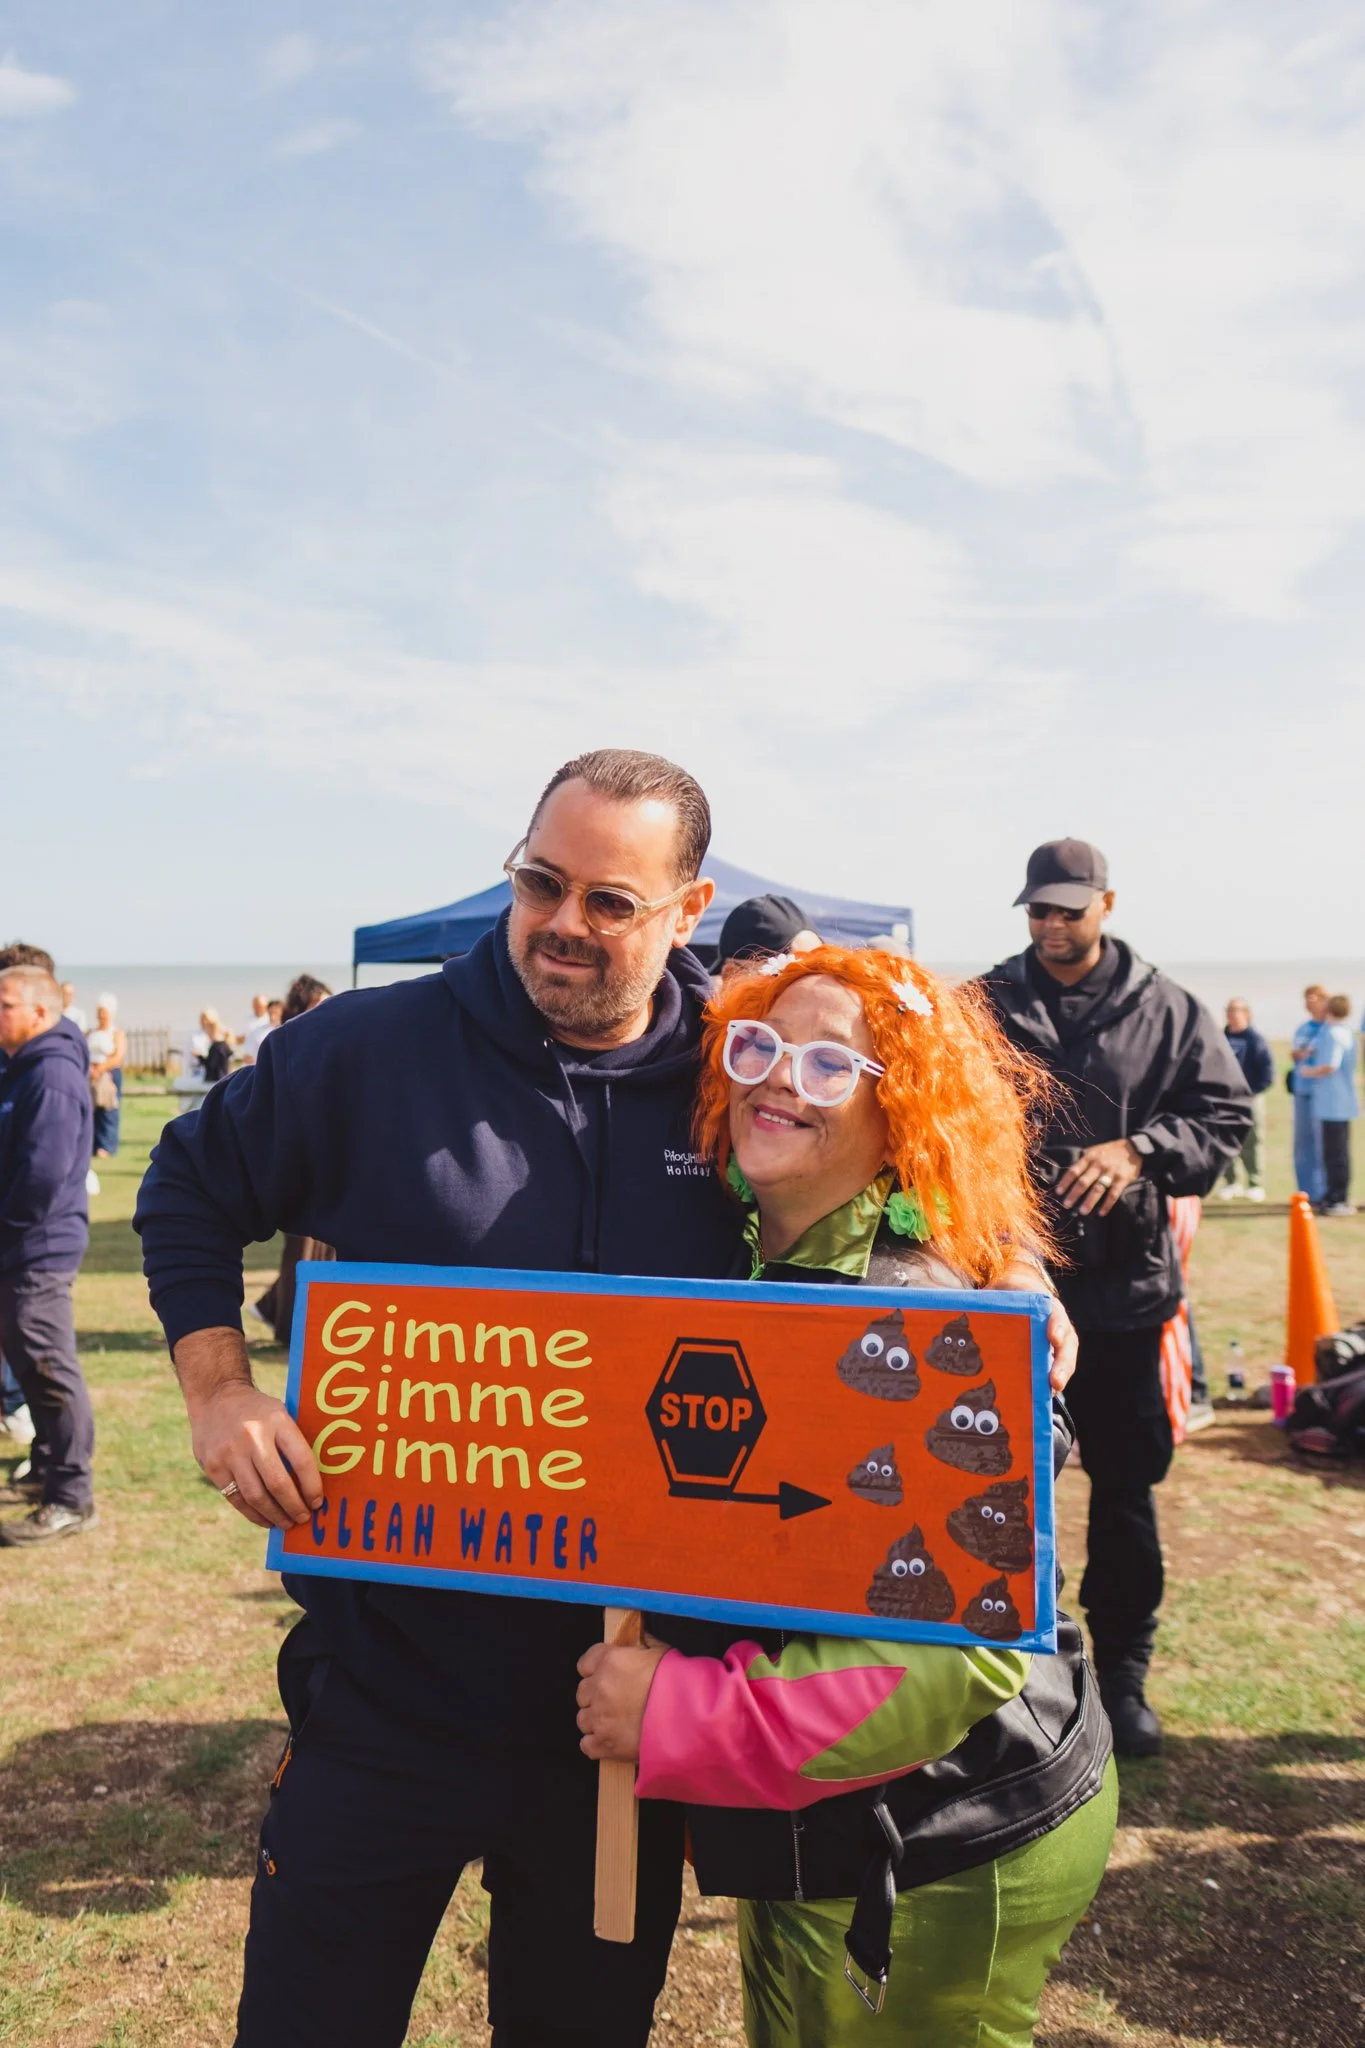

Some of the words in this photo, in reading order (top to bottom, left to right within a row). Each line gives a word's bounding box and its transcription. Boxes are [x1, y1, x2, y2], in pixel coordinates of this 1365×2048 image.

[321, 1300, 593, 1369] Gimme
[315, 1360, 589, 1428] Gimme
[660, 1392, 753, 1432] STOP
[311, 1419, 587, 1490] Gimme
[311, 1497, 435, 1557] CLEAN
[460, 1507, 597, 1571] WATER
